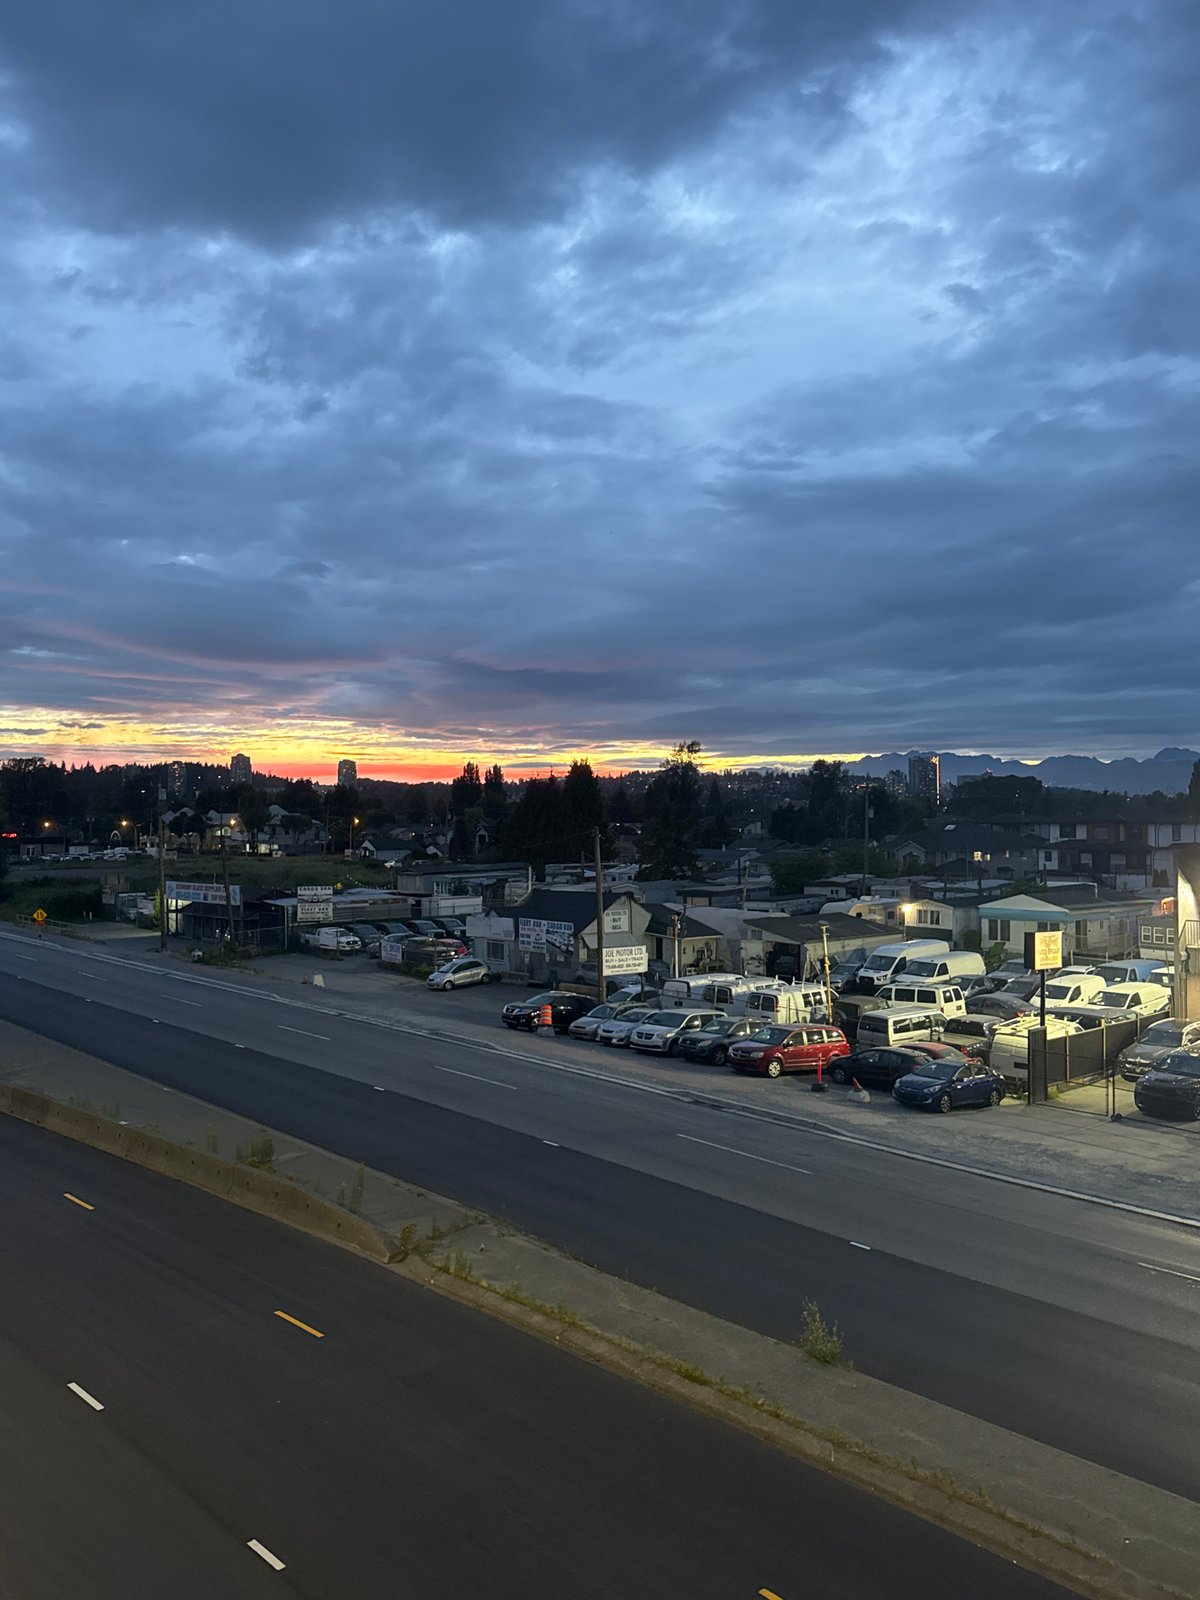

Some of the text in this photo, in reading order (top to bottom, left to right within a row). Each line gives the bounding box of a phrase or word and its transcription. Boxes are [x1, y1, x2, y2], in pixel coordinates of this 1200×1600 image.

[546, 921, 563, 930] CARGO
[563, 923, 573, 931] VAN
[605, 949, 614, 958] JOE
[616, 949, 633, 957] MOTOR
